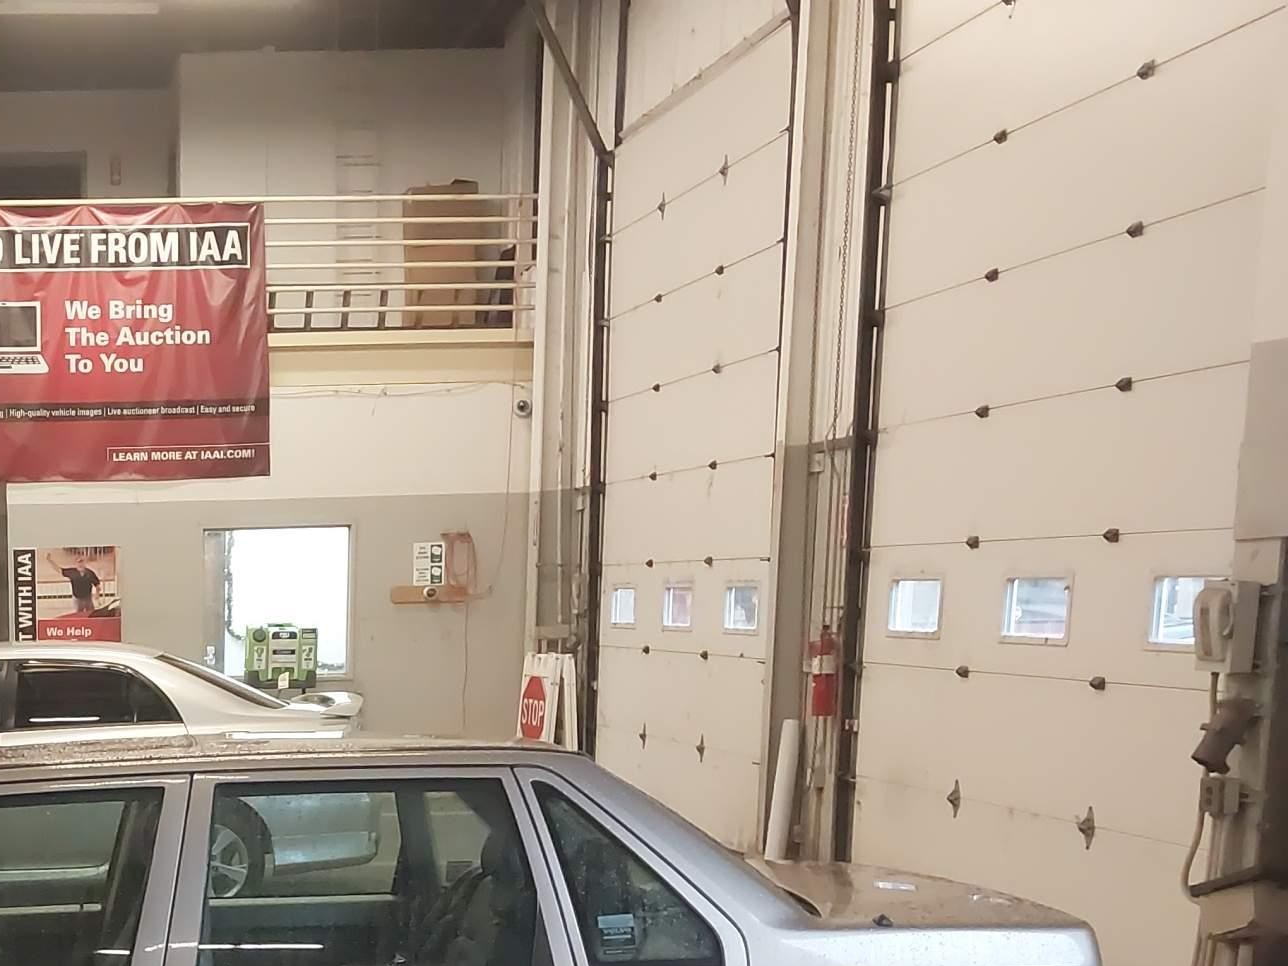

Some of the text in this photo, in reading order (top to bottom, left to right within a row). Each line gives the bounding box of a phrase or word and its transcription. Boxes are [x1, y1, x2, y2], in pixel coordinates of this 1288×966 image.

[14, 233, 81, 265] LIVE
[90, 231, 179, 264] FROM
[189, 230, 243, 262] IAA
[64, 299, 174, 323] We Bring
[64, 325, 211, 347] The Auction
[64, 352, 144, 374] To You
[9, 407, 51, 419] High-quality
[51, 407, 77, 417] vehicle
[77, 407, 102, 418] images
[107, 407, 122, 416] Live
[122, 406, 160, 416] auctioneer
[160, 405, 196, 415] broadcast
[200, 404, 217, 415] Easy
[217, 404, 231, 413] and
[231, 404, 256, 413] secure
[112, 448, 256, 462] LEARN MORE AT IAAI.COM!
[17, 552, 32, 581] IAA
[18, 586, 33, 629] WITH
[46, 626, 92, 637] We Help
[521, 698, 545, 727] STOP
